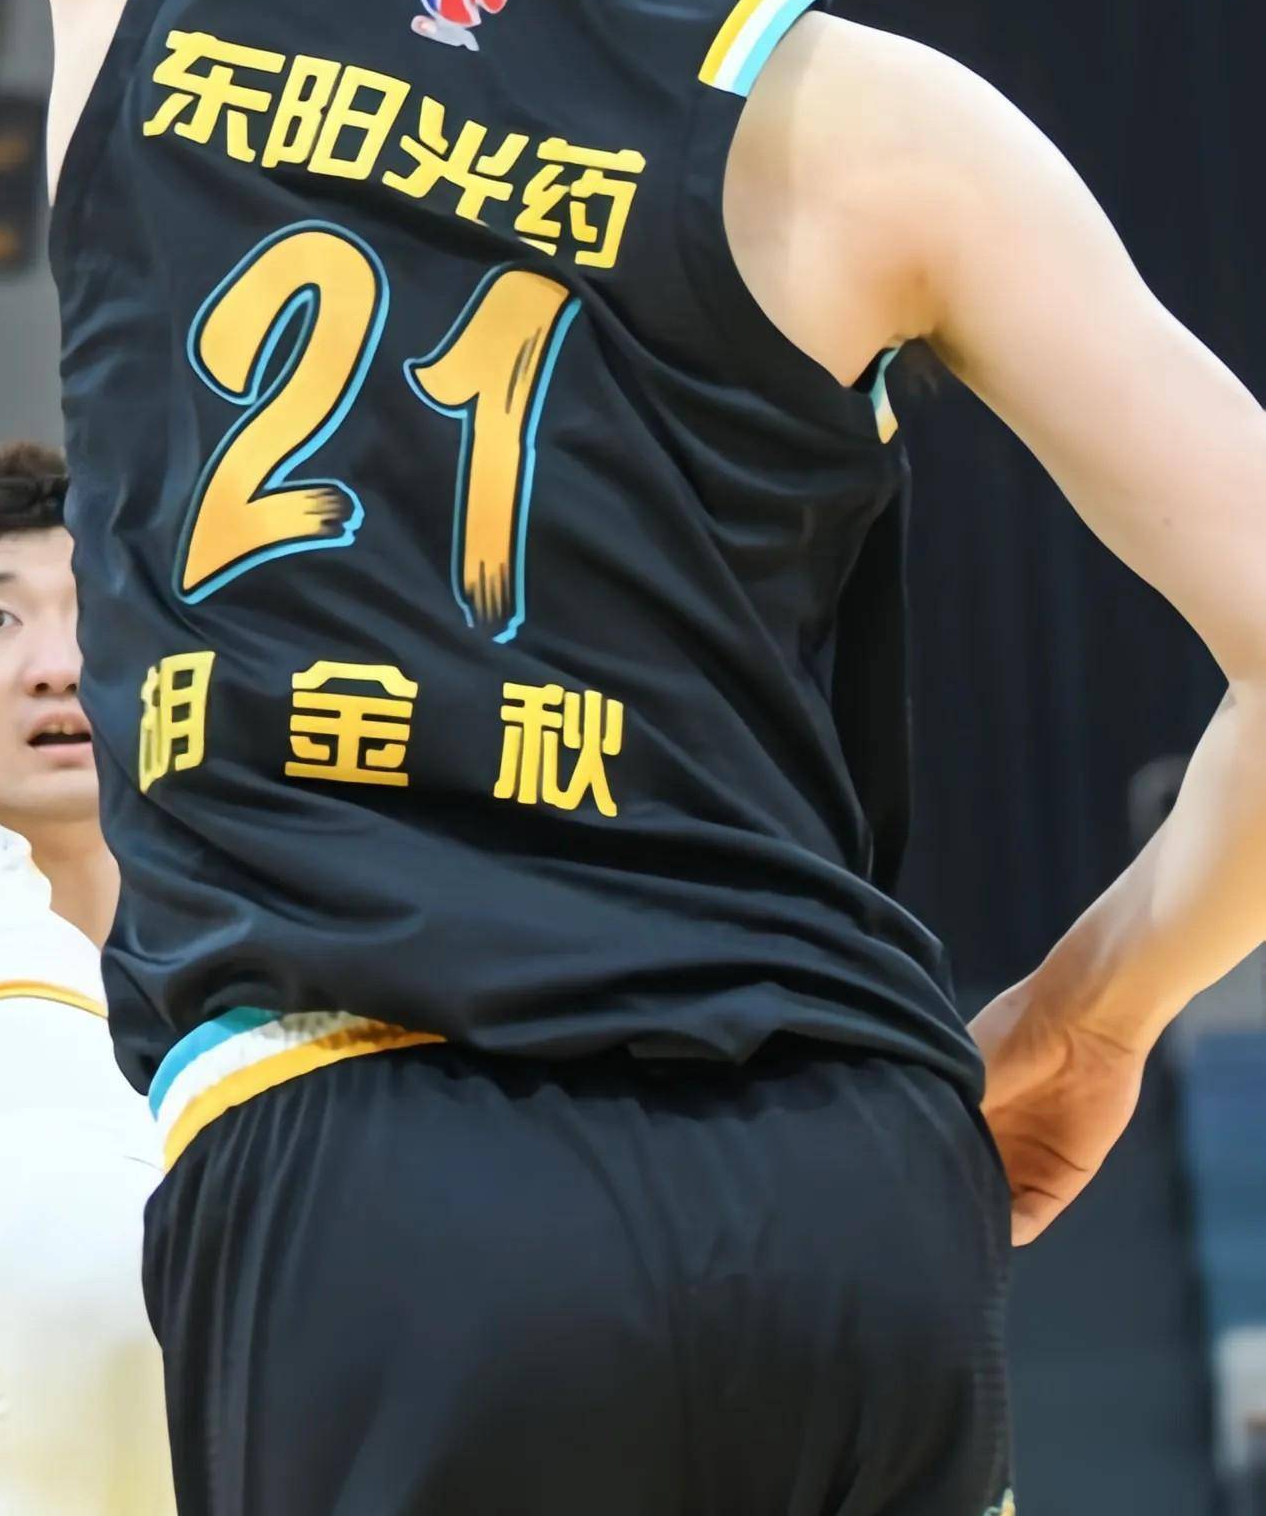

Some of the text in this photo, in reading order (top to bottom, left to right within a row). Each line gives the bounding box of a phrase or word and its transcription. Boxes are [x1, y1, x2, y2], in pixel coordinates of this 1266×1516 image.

[143, 30, 646, 268] 东阳光药
[172, 220, 582, 644] 21
